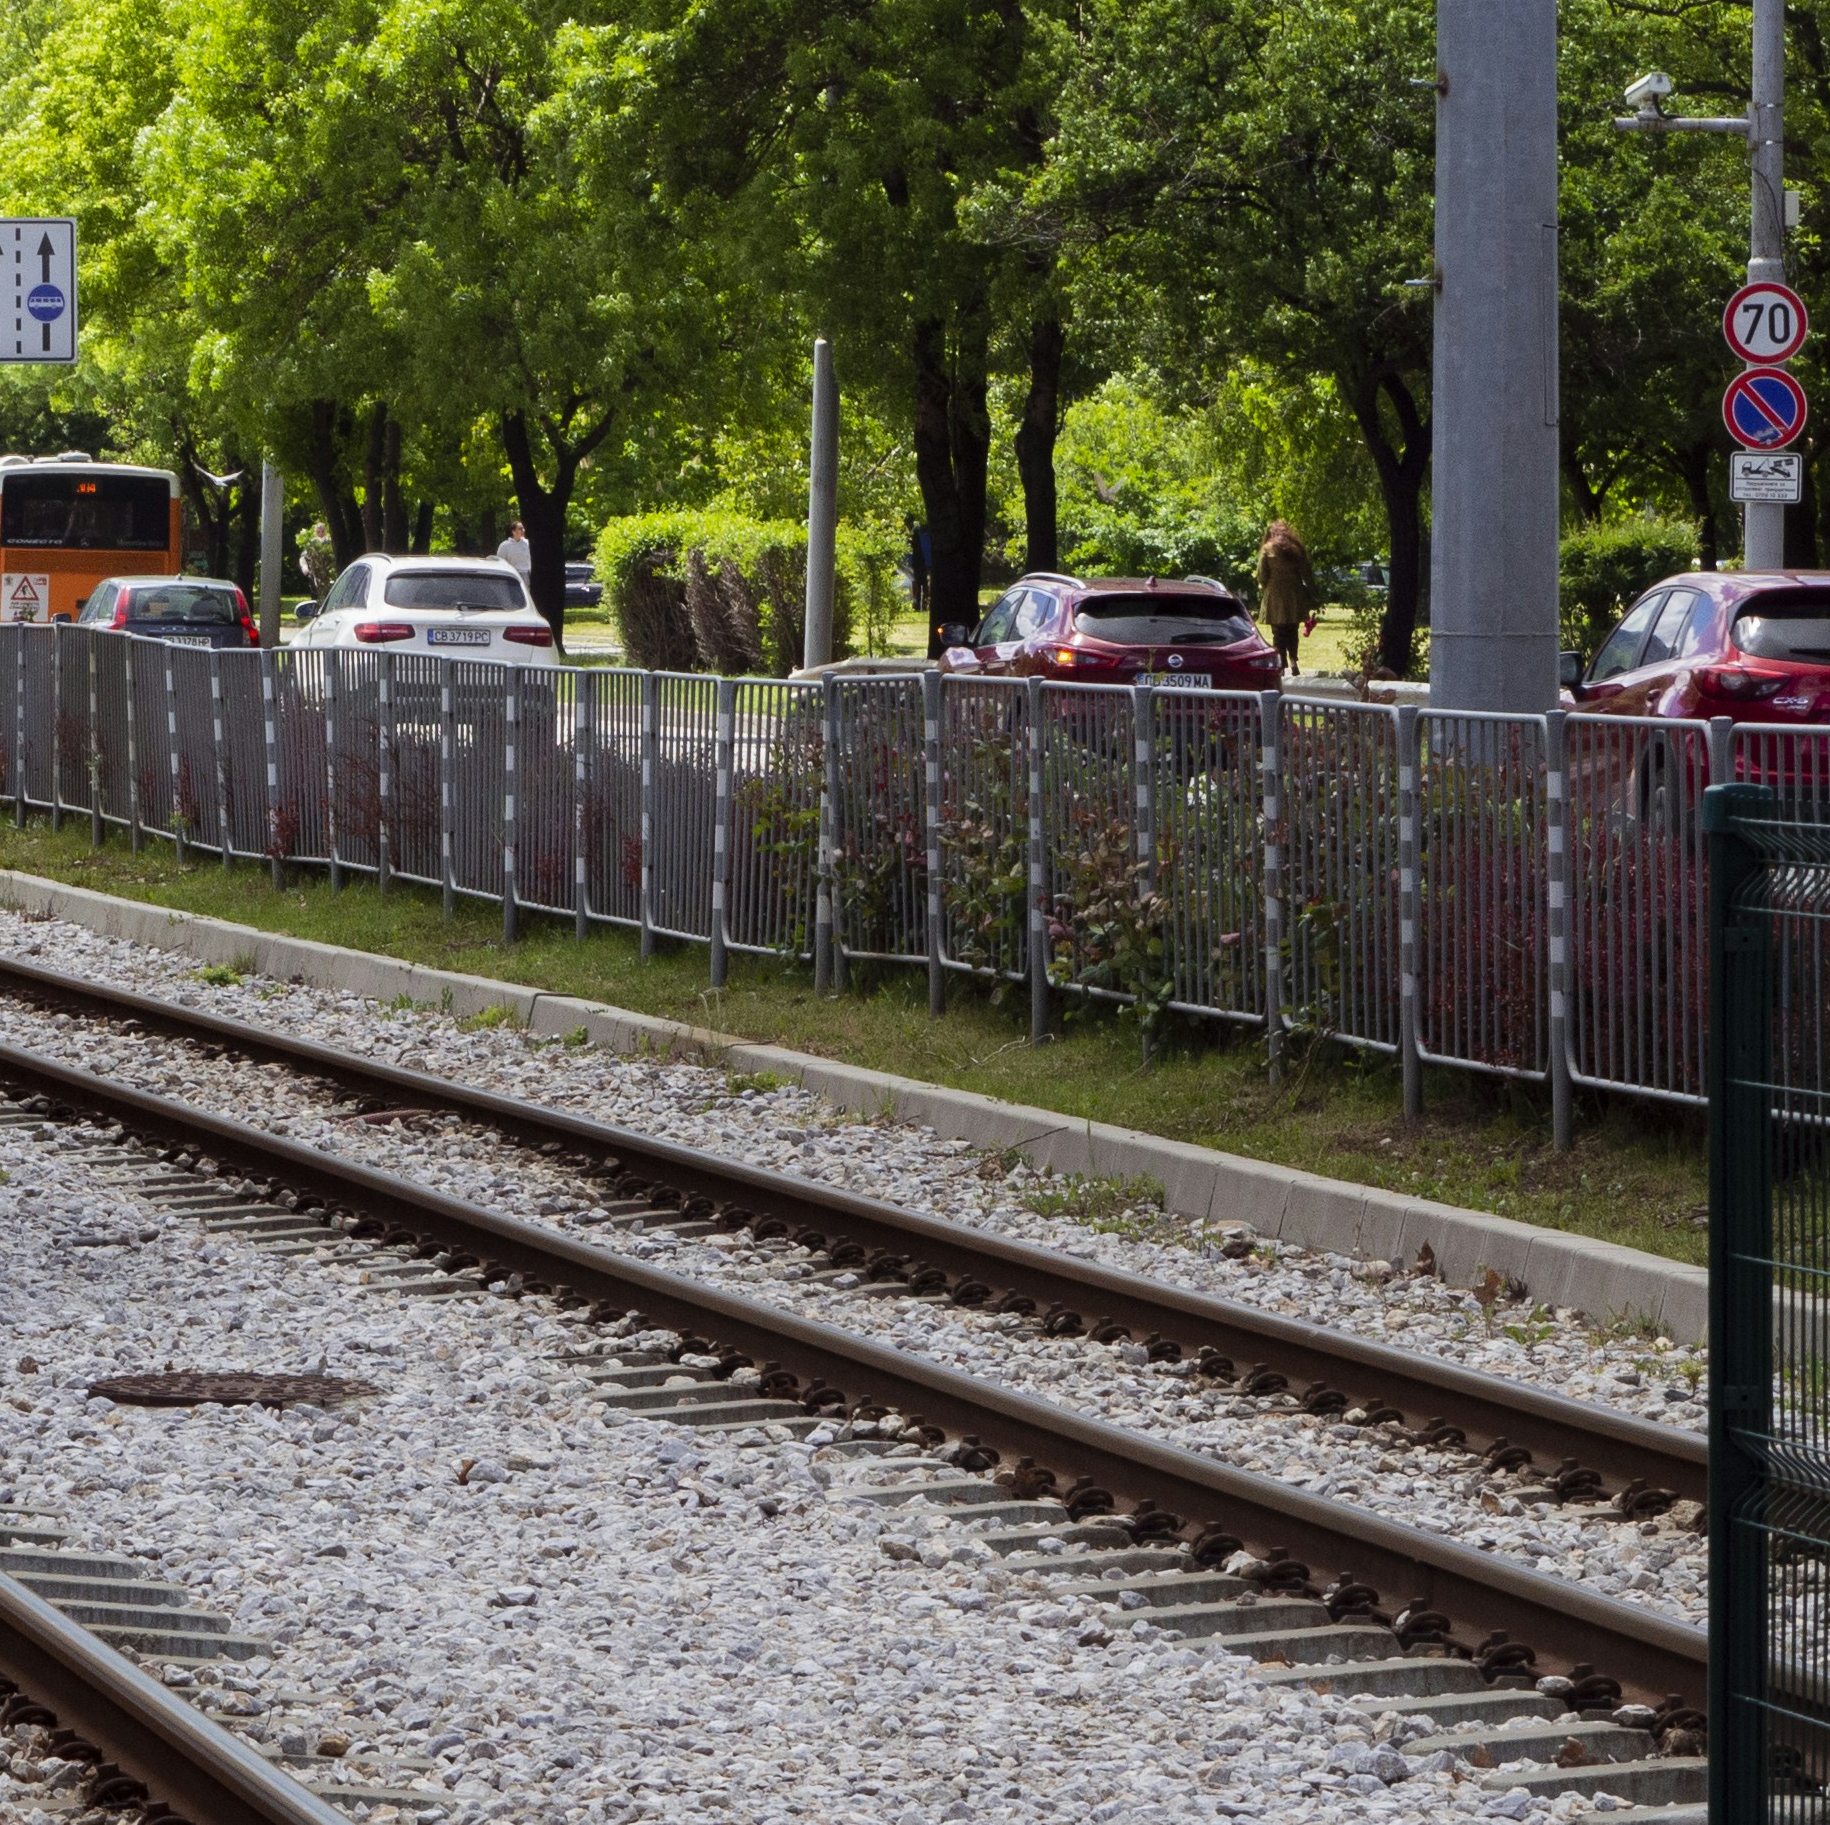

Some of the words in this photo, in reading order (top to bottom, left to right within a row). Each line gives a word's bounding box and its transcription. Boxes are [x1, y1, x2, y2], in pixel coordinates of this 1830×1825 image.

[1741, 302, 1791, 345] 70
[435, 630, 448, 642] CB
[449, 631, 473, 642] 3719
[474, 631, 488, 642] PC
[1162, 675, 1192, 688] 3509
[1193, 675, 1209, 688] MA
